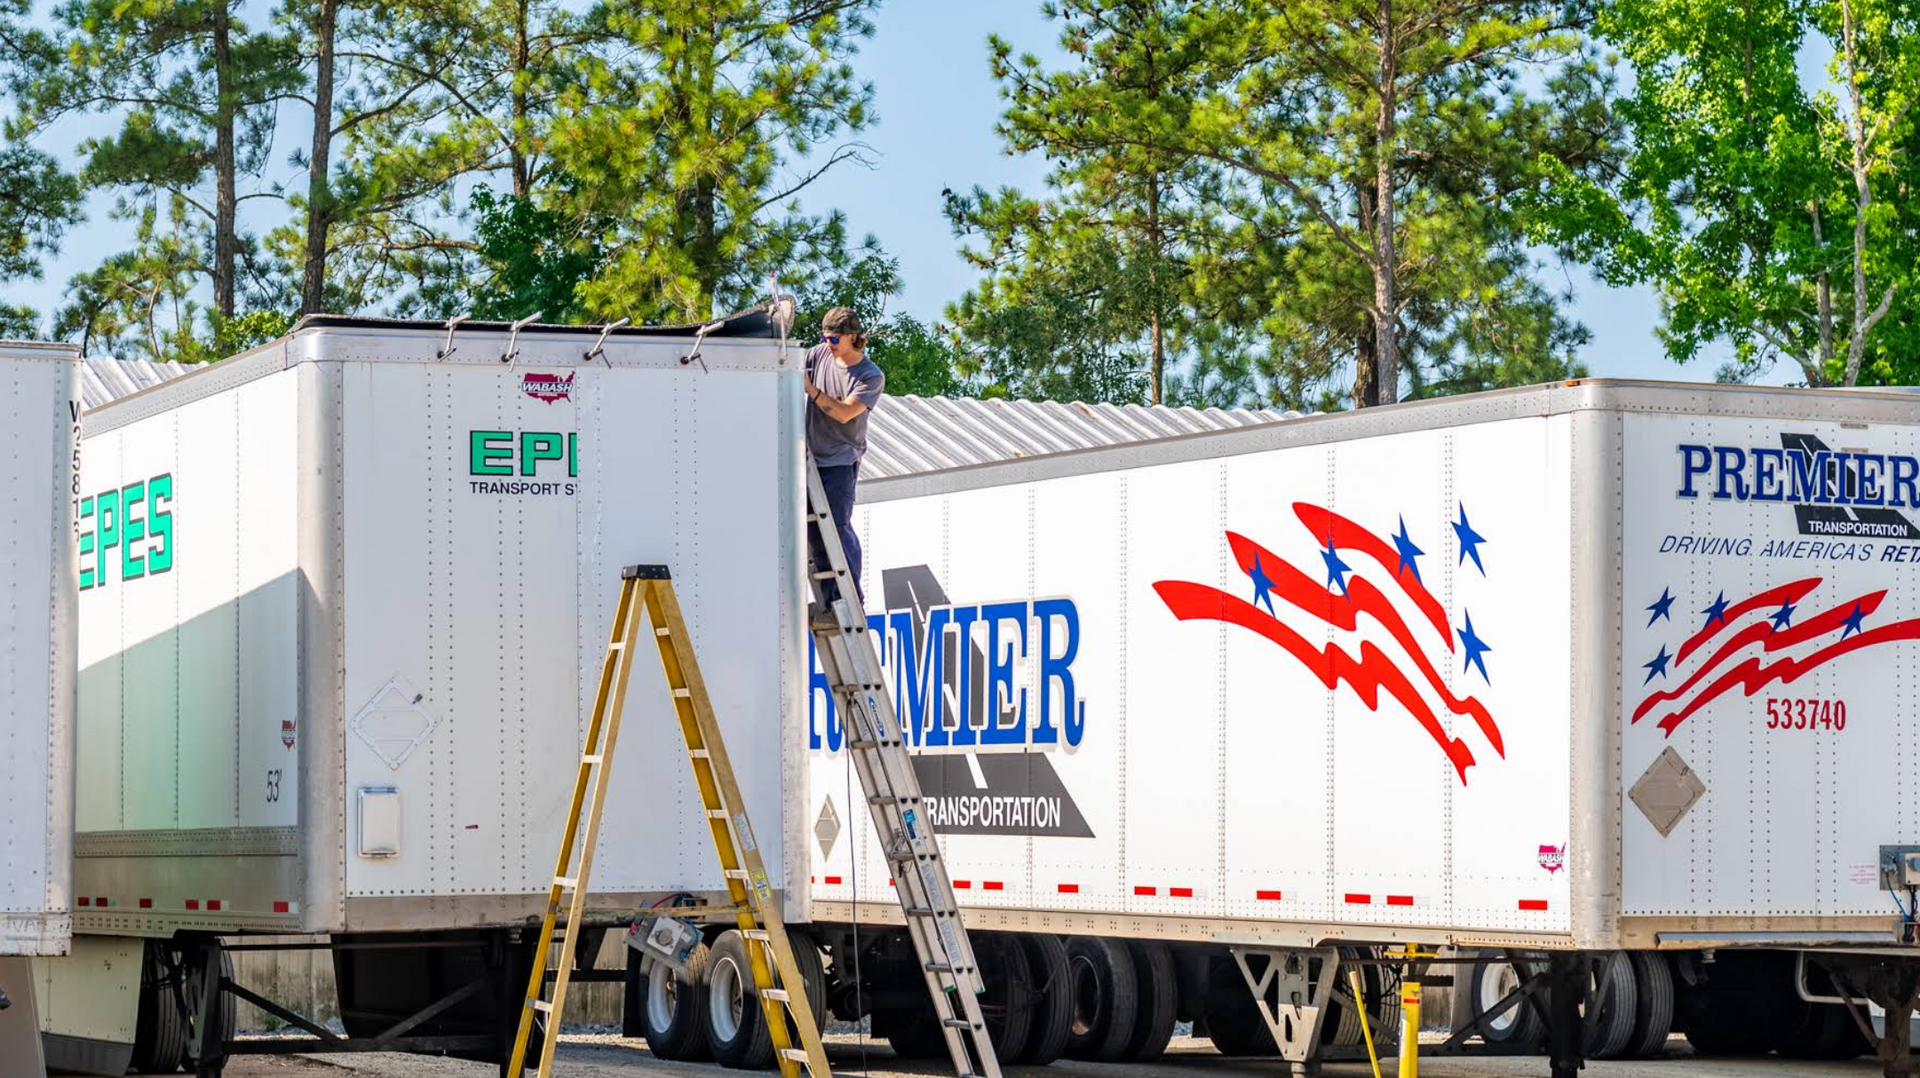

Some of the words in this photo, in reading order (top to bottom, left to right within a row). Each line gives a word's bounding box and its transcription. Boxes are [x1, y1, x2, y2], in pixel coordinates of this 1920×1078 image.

[522, 382, 573, 393] WABASH
[469, 430, 577, 478] EP
[469, 481, 561, 496] TRANSPORT
[565, 483, 578, 496] S
[1676, 444, 1920, 509] PREMIER
[1808, 520, 1908, 537] TRANSPORTATION
[1659, 535, 1752, 556] DRIVING
[1759, 539, 1874, 561] AMERICA'S
[1880, 544, 1920, 563] RET
[1766, 698, 1846, 731] 533740
